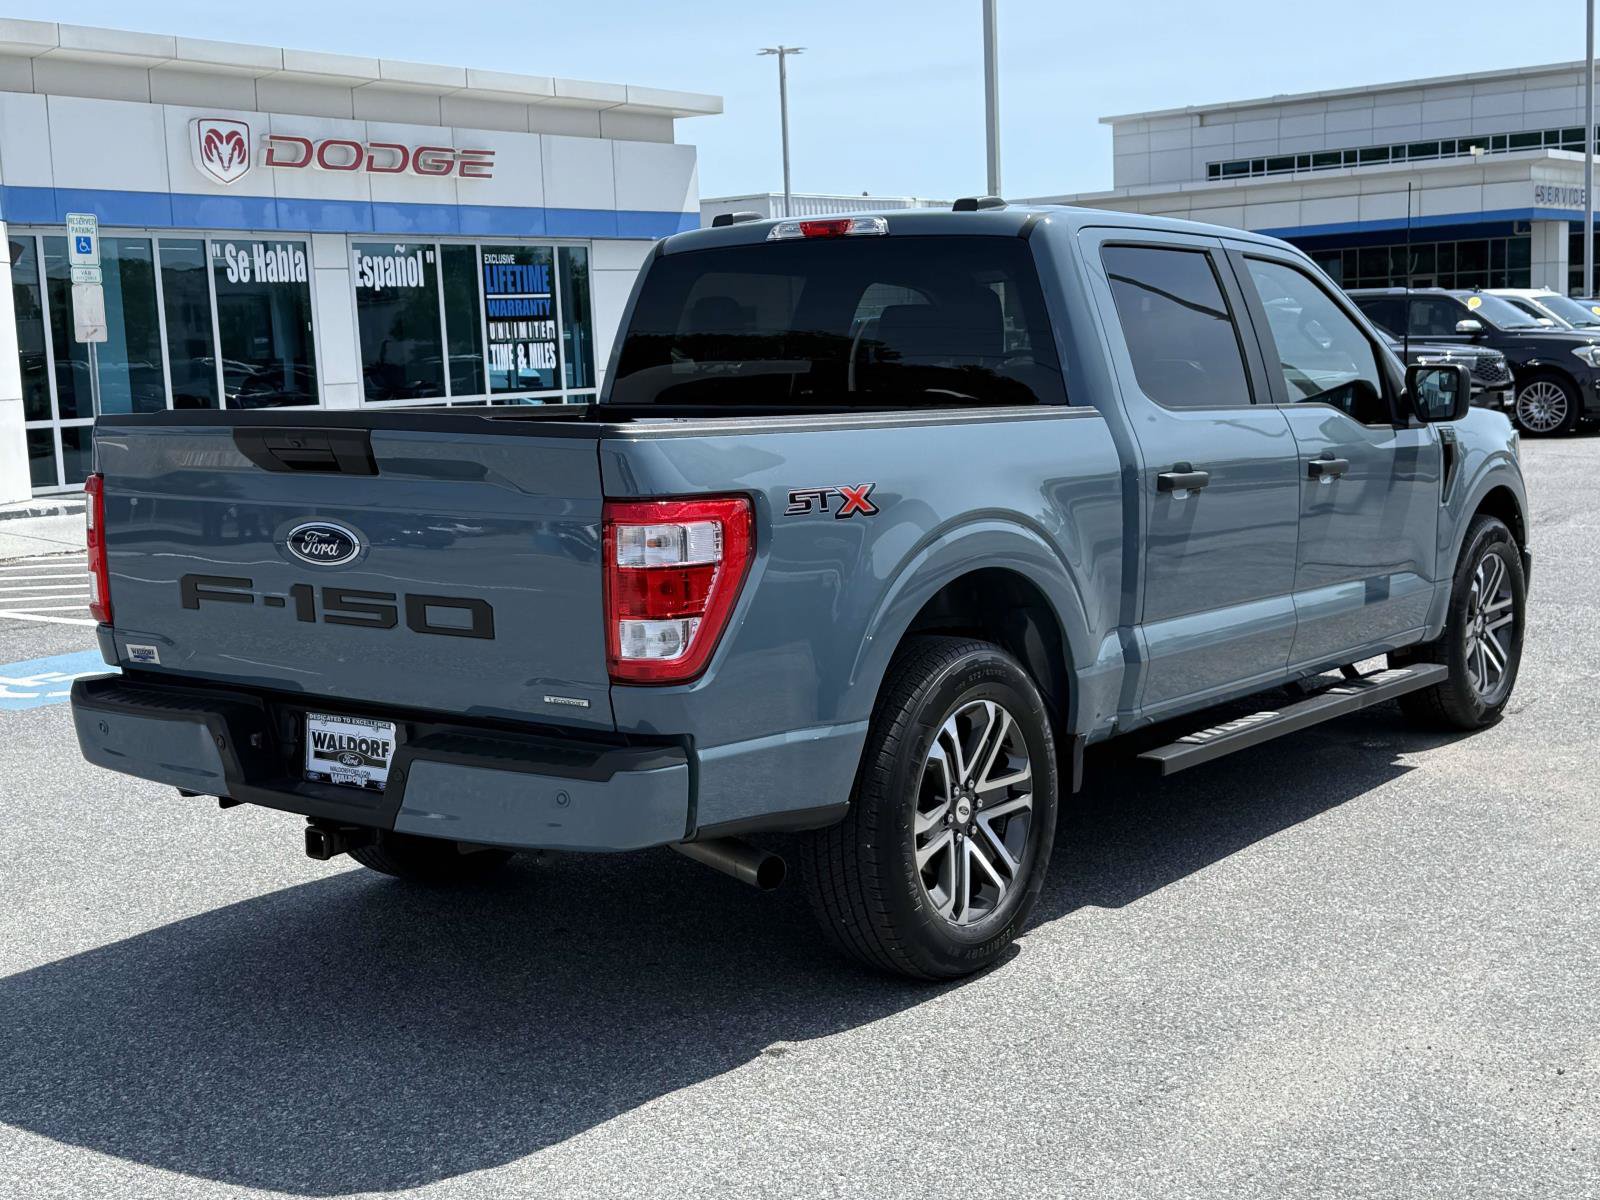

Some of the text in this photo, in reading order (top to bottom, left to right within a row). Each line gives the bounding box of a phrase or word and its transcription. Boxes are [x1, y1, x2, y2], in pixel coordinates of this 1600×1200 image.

[265, 134, 496, 179] DODGE
[1537, 185, 1585, 205] SERVICE
[70, 226, 95, 235] PARKING
[253, 243, 307, 283] Habla
[484, 253, 516, 265] EXCLUSIVE
[485, 264, 550, 293] LIFETIME
[487, 299, 551, 317] WARRANTY
[490, 341, 557, 371] TIME & MILES
[783, 483, 880, 520] STX
[301, 530, 340, 557] Ford
[180, 573, 496, 640] F-150
[309, 713, 342, 722] DEDICATED
[352, 718, 390, 729] EXCELLENCE
[311, 731, 389, 758] WALDORF
[342, 754, 360, 766] Ford
